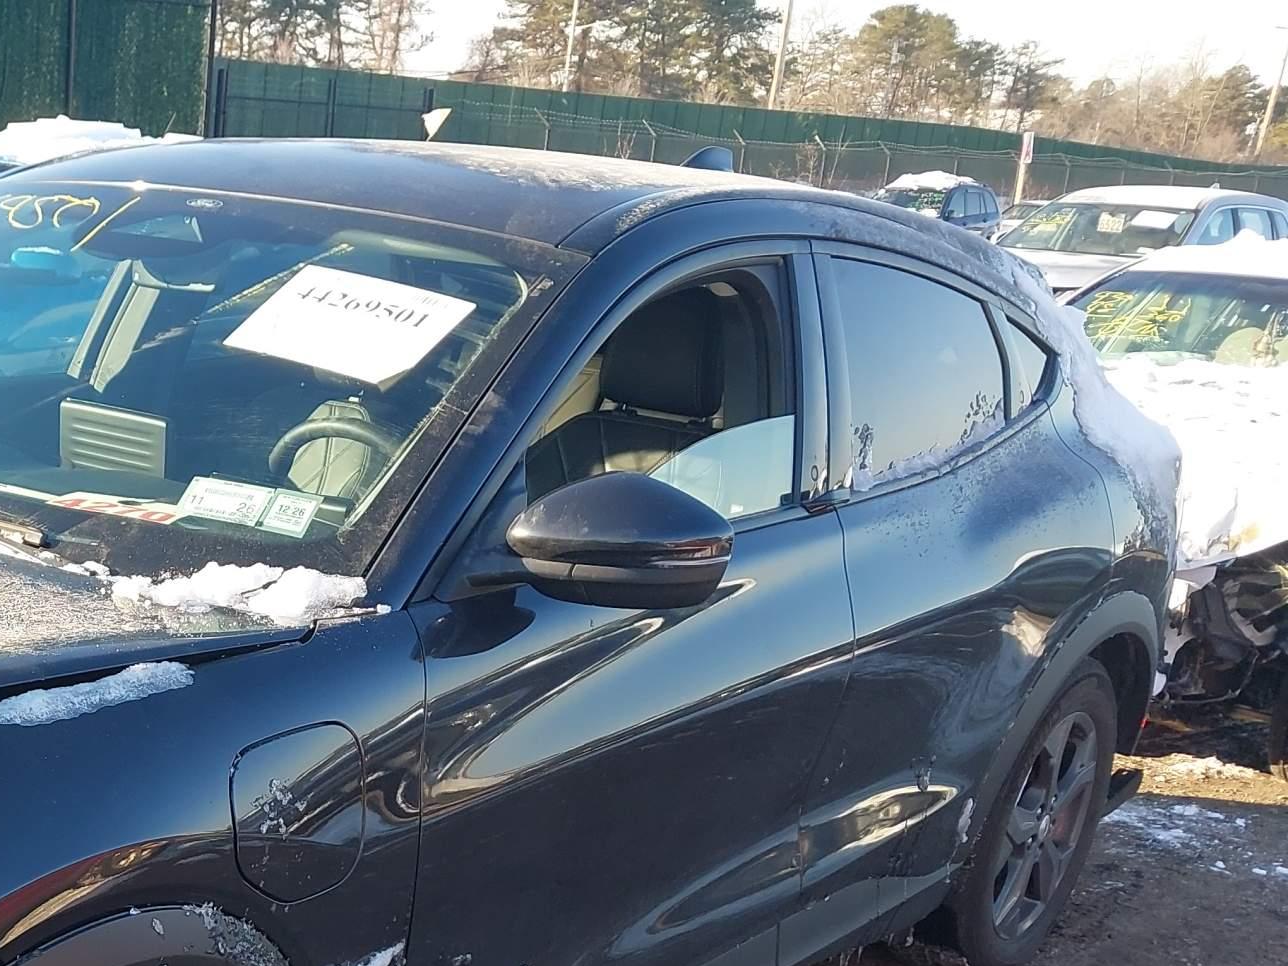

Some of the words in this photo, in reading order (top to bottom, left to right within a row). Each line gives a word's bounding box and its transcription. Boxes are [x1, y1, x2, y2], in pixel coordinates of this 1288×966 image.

[296, 287, 430, 328] 44269501
[51, 498, 177, 522] 4270
[236, 502, 257, 515] 26
[277, 503, 290, 514] 12
[291, 505, 306, 518] 26
